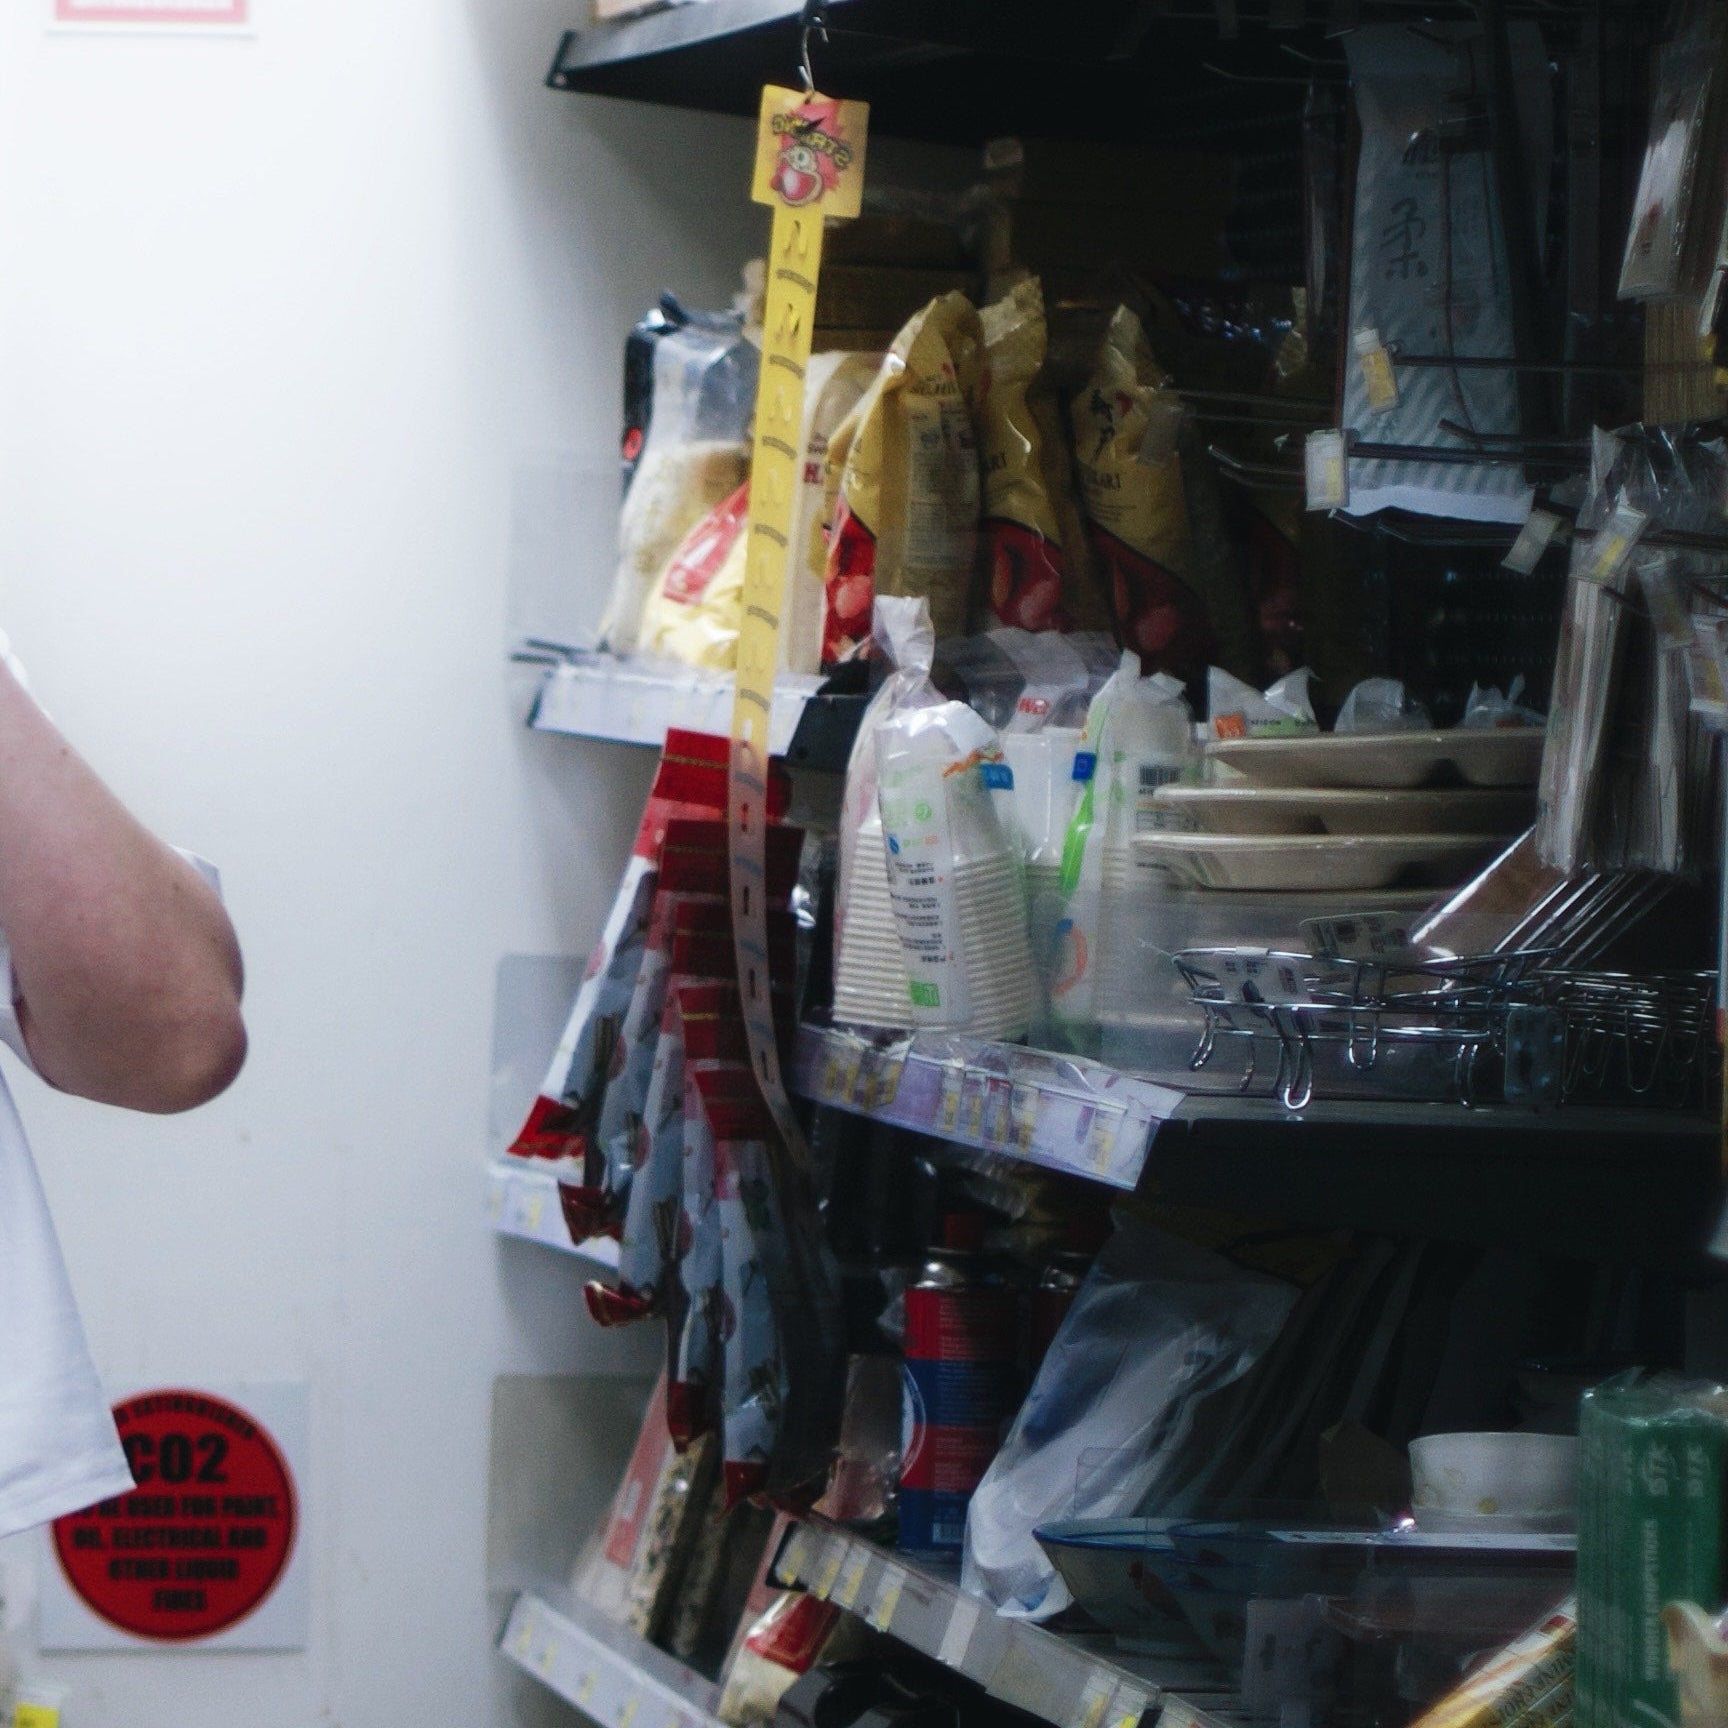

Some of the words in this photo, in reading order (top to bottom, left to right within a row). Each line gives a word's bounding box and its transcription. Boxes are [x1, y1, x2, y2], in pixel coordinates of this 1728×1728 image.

[122, 1433, 229, 1485] CO2
[127, 1496, 174, 1517] USED
[181, 1496, 216, 1517] FOR
[112, 1527, 221, 1549] ELECTRICAL
[228, 1527, 267, 1548] AND
[109, 1558, 168, 1580] OTHER
[176, 1558, 238, 1580] LIQUID
